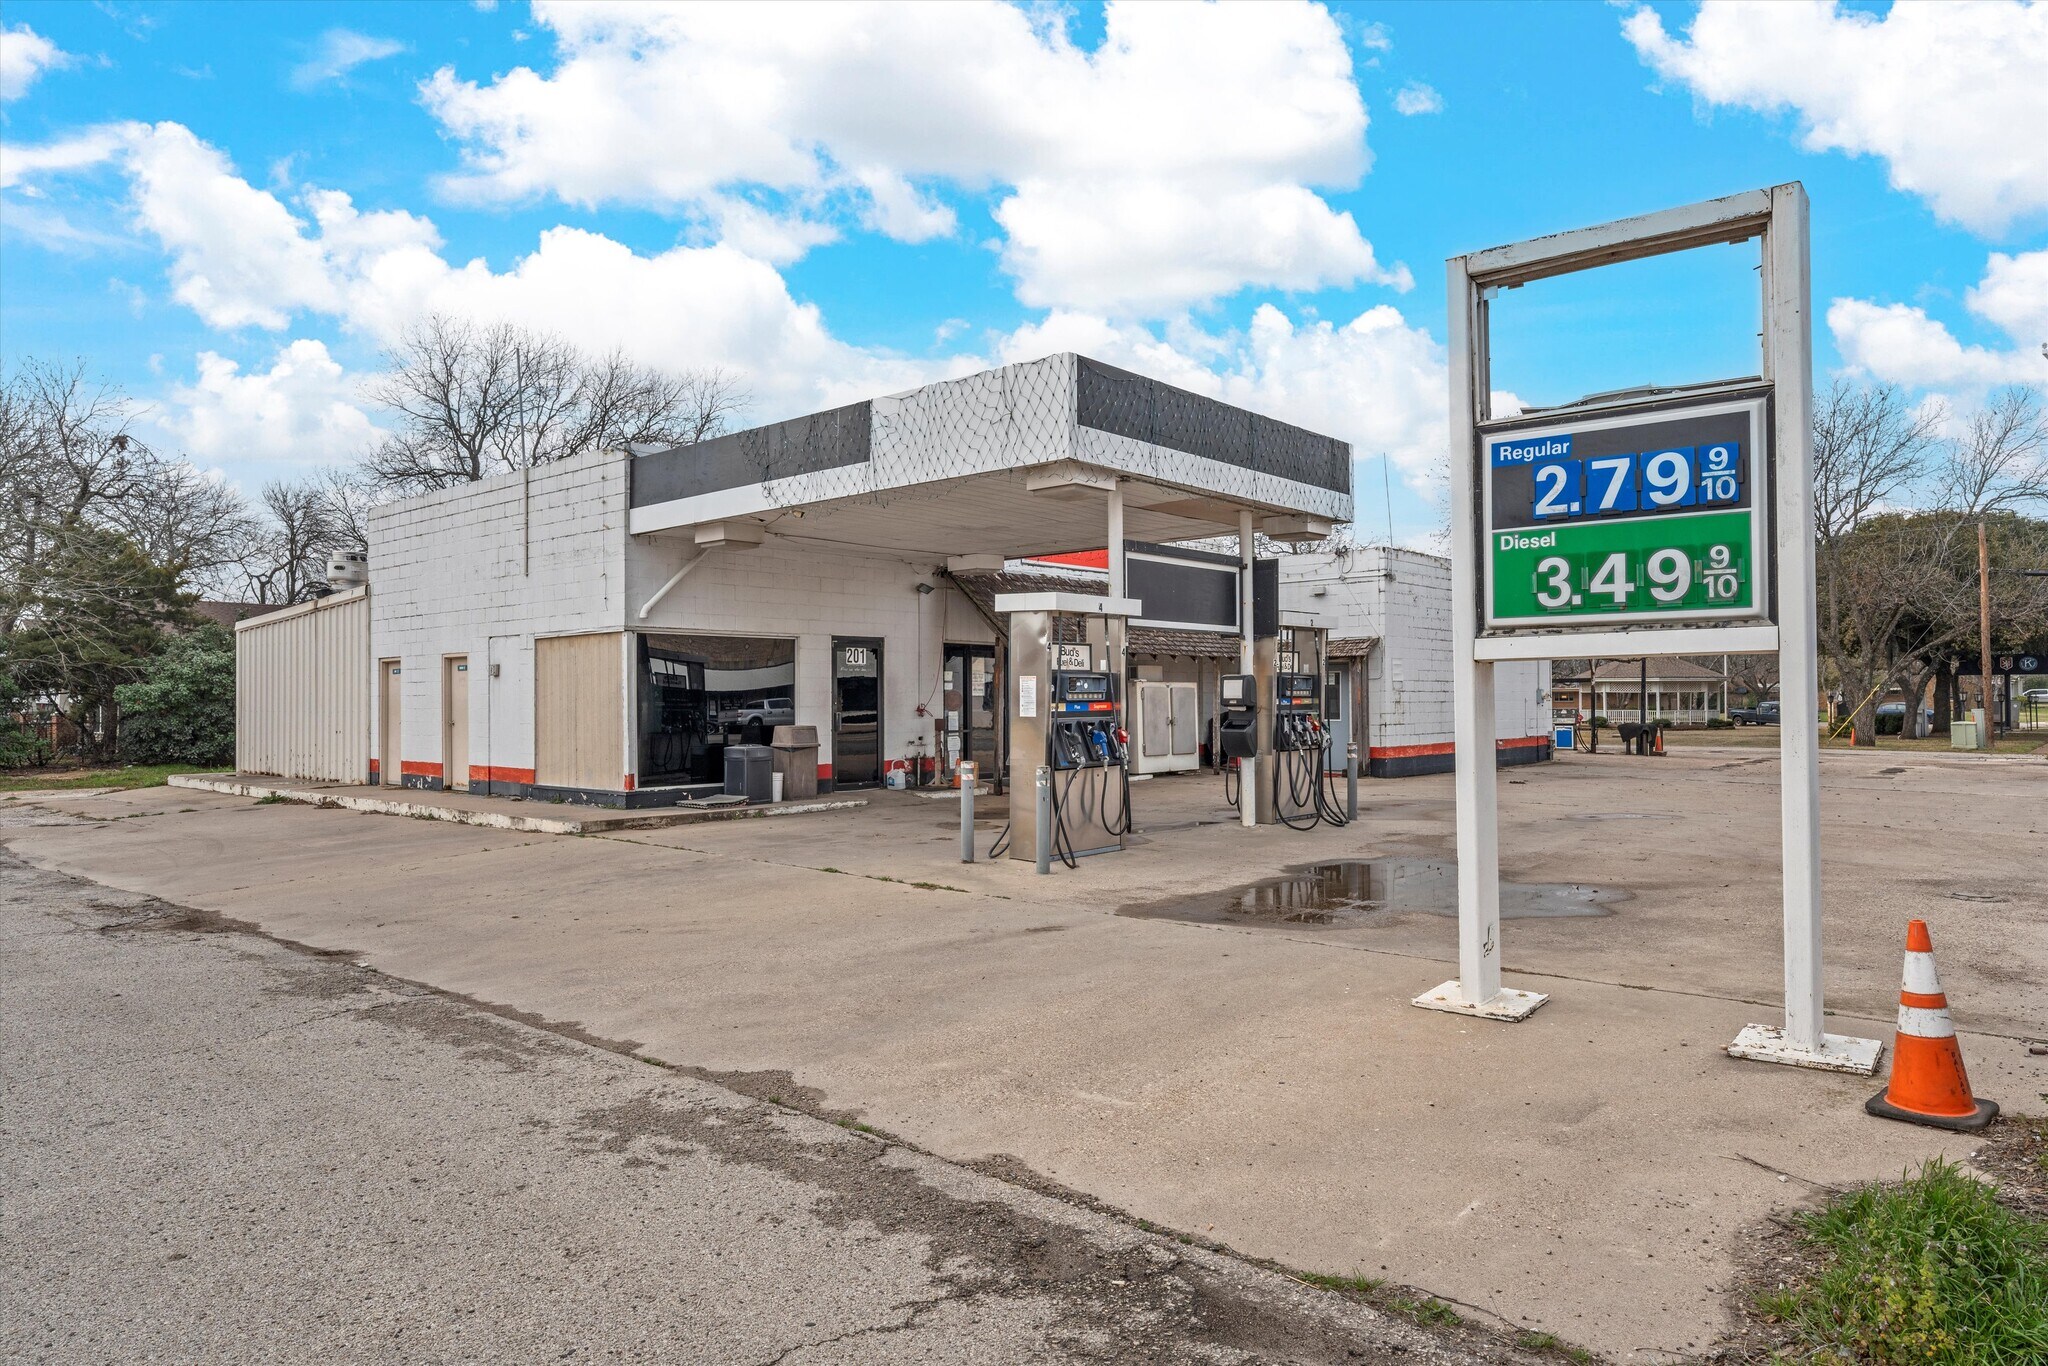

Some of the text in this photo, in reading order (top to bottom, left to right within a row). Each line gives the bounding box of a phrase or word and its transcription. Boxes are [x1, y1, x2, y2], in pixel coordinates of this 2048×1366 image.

[1499, 440, 1570, 463] Regular
[1535, 451, 1690, 515] 2.79
[1500, 532, 1556, 551] Diesel
[1536, 547, 1692, 607] 3.49
[1098, 602, 1103, 612] 4
[846, 648, 865, 664] 201
[1060, 645, 1080, 658] Bud's
[1068, 657, 1074, 666] &
[1073, 658, 1085, 668] Deli
